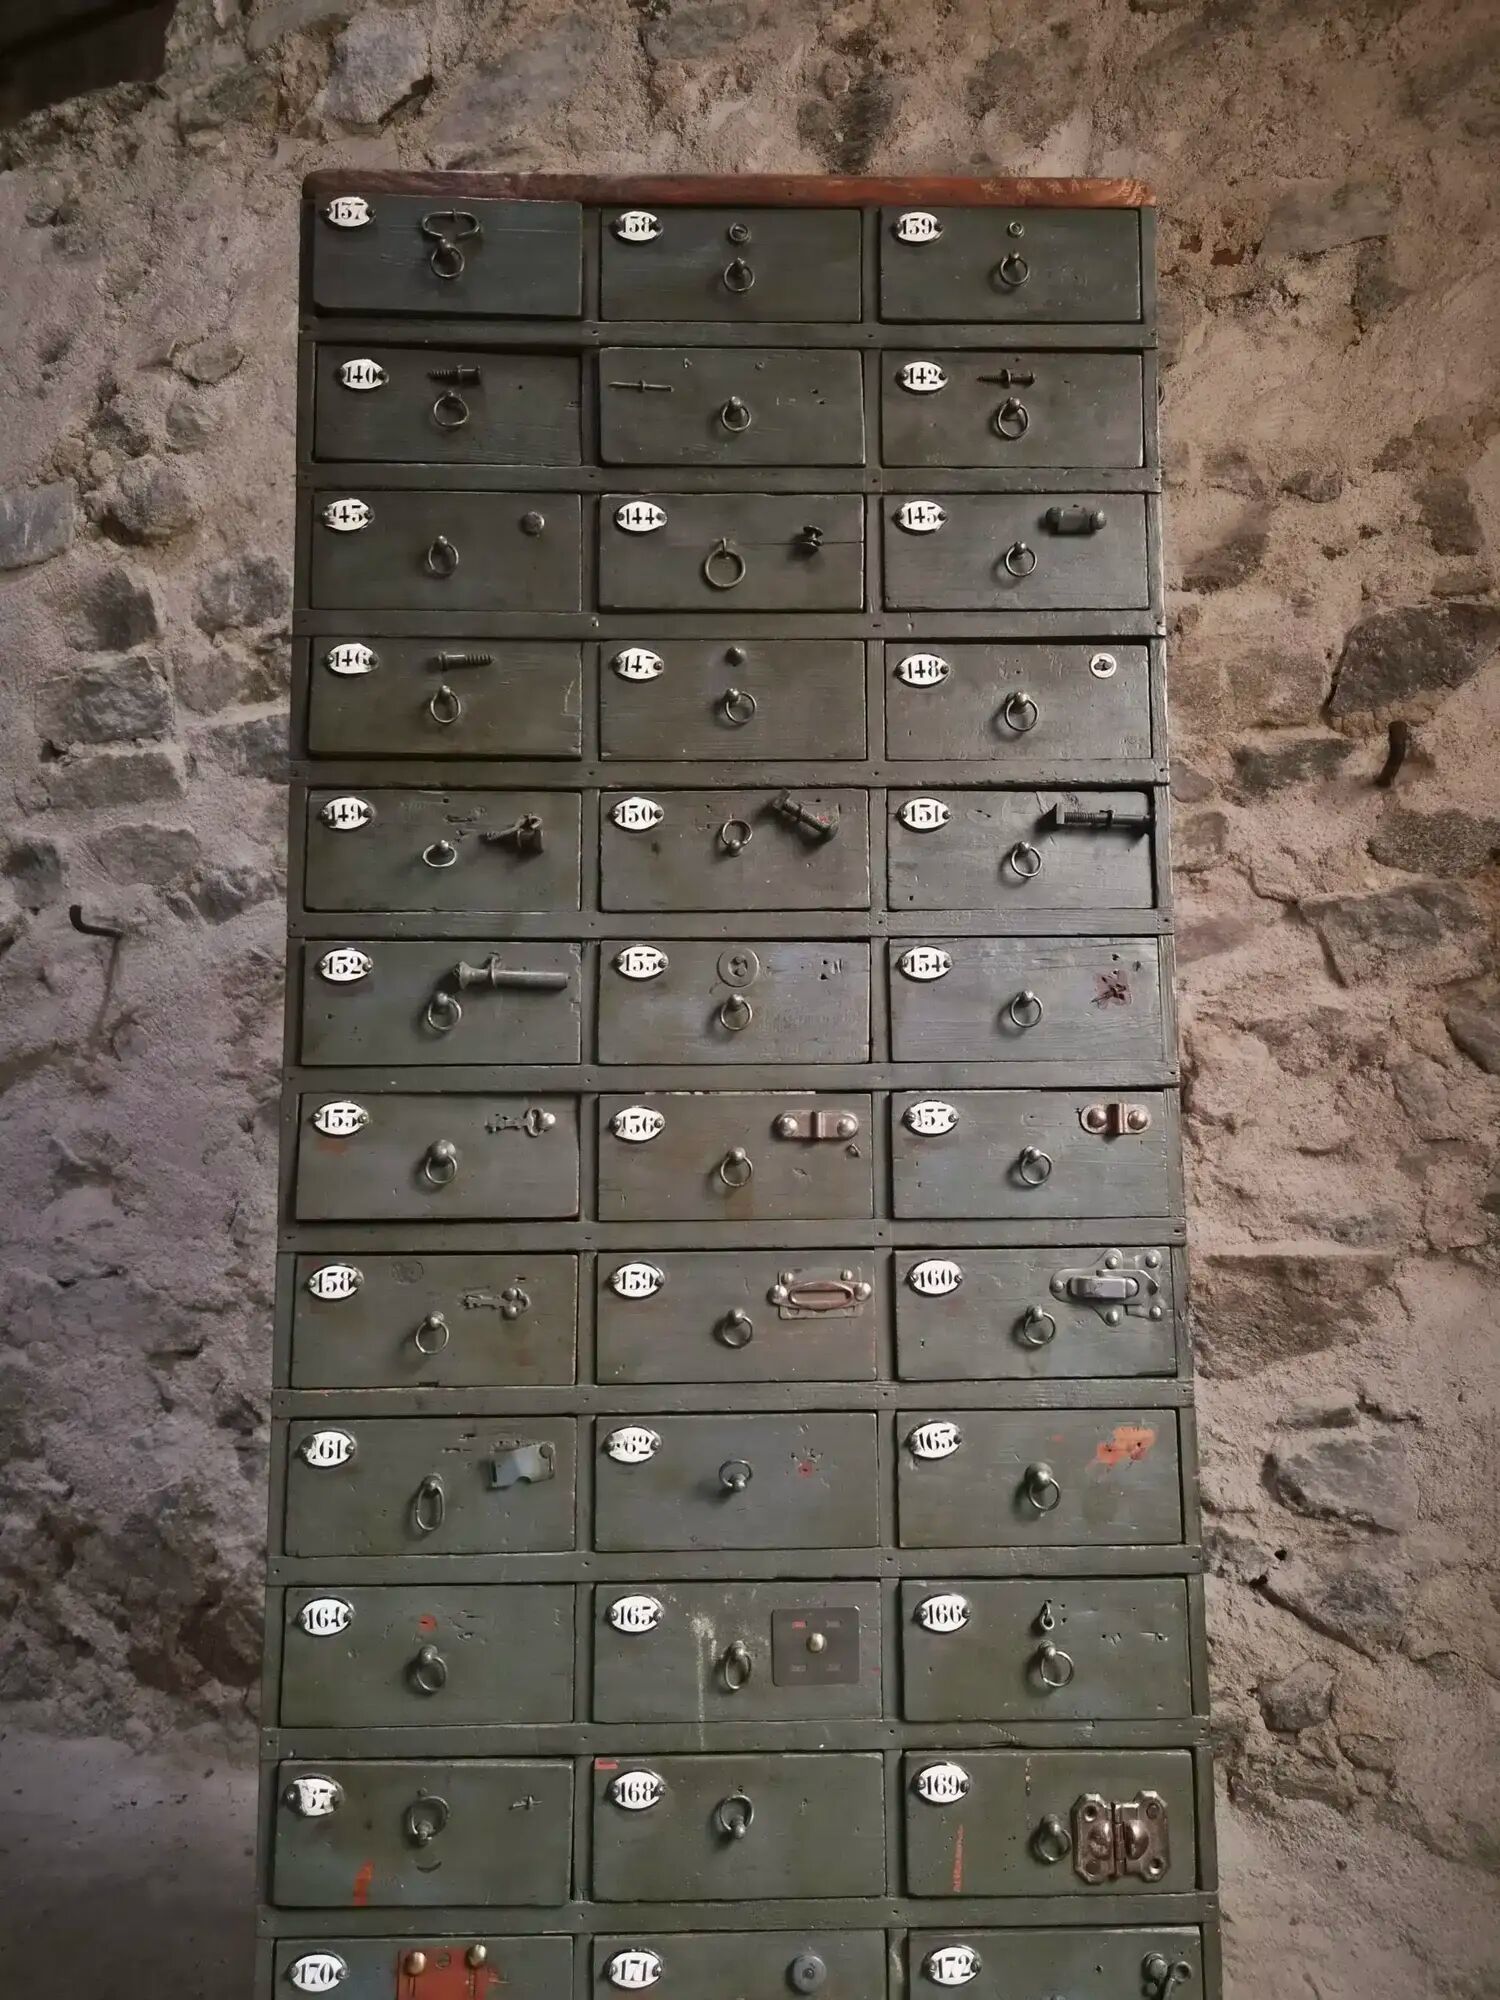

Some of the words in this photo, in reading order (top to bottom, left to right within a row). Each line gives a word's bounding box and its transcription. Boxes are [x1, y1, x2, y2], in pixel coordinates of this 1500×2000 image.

[333, 202, 365, 219] 137
[623, 216, 657, 234] 138
[902, 216, 933, 234] 139
[346, 368, 377, 382] 140
[910, 367, 938, 384] 142
[625, 509, 657, 524] 144
[907, 507, 939, 524] 145
[334, 650, 369, 666] 146
[625, 655, 655, 672] 147
[908, 660, 941, 677] 148
[330, 804, 364, 822] 149
[620, 805, 653, 823] 150
[910, 804, 943, 822] 151
[328, 957, 363, 974] 152
[625, 954, 660, 971] 153
[910, 955, 941, 972] 154
[325, 1110, 359, 1128] 155
[622, 1115, 656, 1134] 156
[319, 1273, 352, 1291] 158
[621, 1272, 655, 1290] 159
[920, 1268, 952, 1286] 160
[615, 1435, 650, 1454] 62
[919, 1431, 953, 1450] 163
[314, 1441, 342, 1459] 61
[308, 1608, 345, 1627] 164
[621, 1605, 655, 1624] 165
[928, 1604, 962, 1623] 166
[621, 1782, 655, 1801] 168
[927, 1774, 960, 1794] 169
[301, 1963, 334, 1984] 170
[621, 1961, 648, 1981] 171
[939, 1956, 971, 1978] 172
